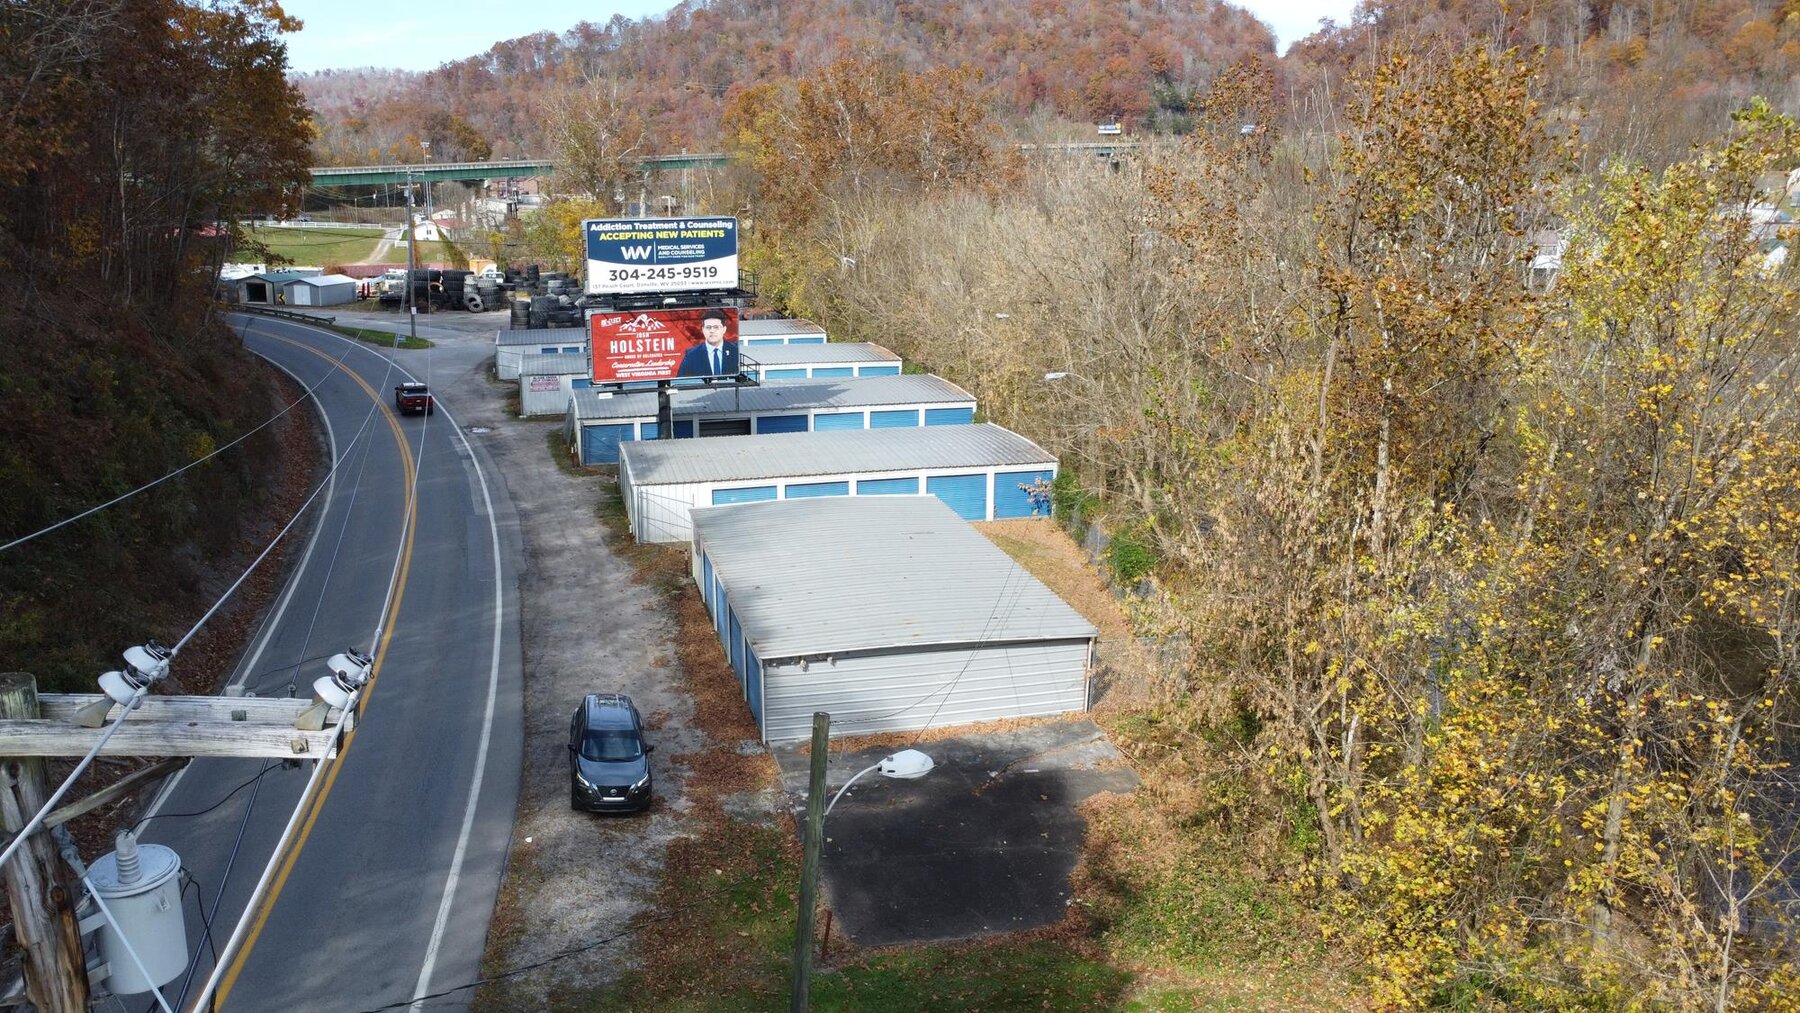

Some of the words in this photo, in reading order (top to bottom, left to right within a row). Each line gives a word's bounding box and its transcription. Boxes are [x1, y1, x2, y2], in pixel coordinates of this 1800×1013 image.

[590, 223, 632, 231] Addiction
[634, 222, 677, 230] Treatment
[687, 220, 733, 229] Counseling
[599, 231, 654, 240] ACCEPTING
[656, 231, 678, 239] NEW
[681, 230, 725, 238] PATIENTS
[609, 266, 718, 281] 304-245-9519
[610, 338, 675, 354] HOLSTEIN
